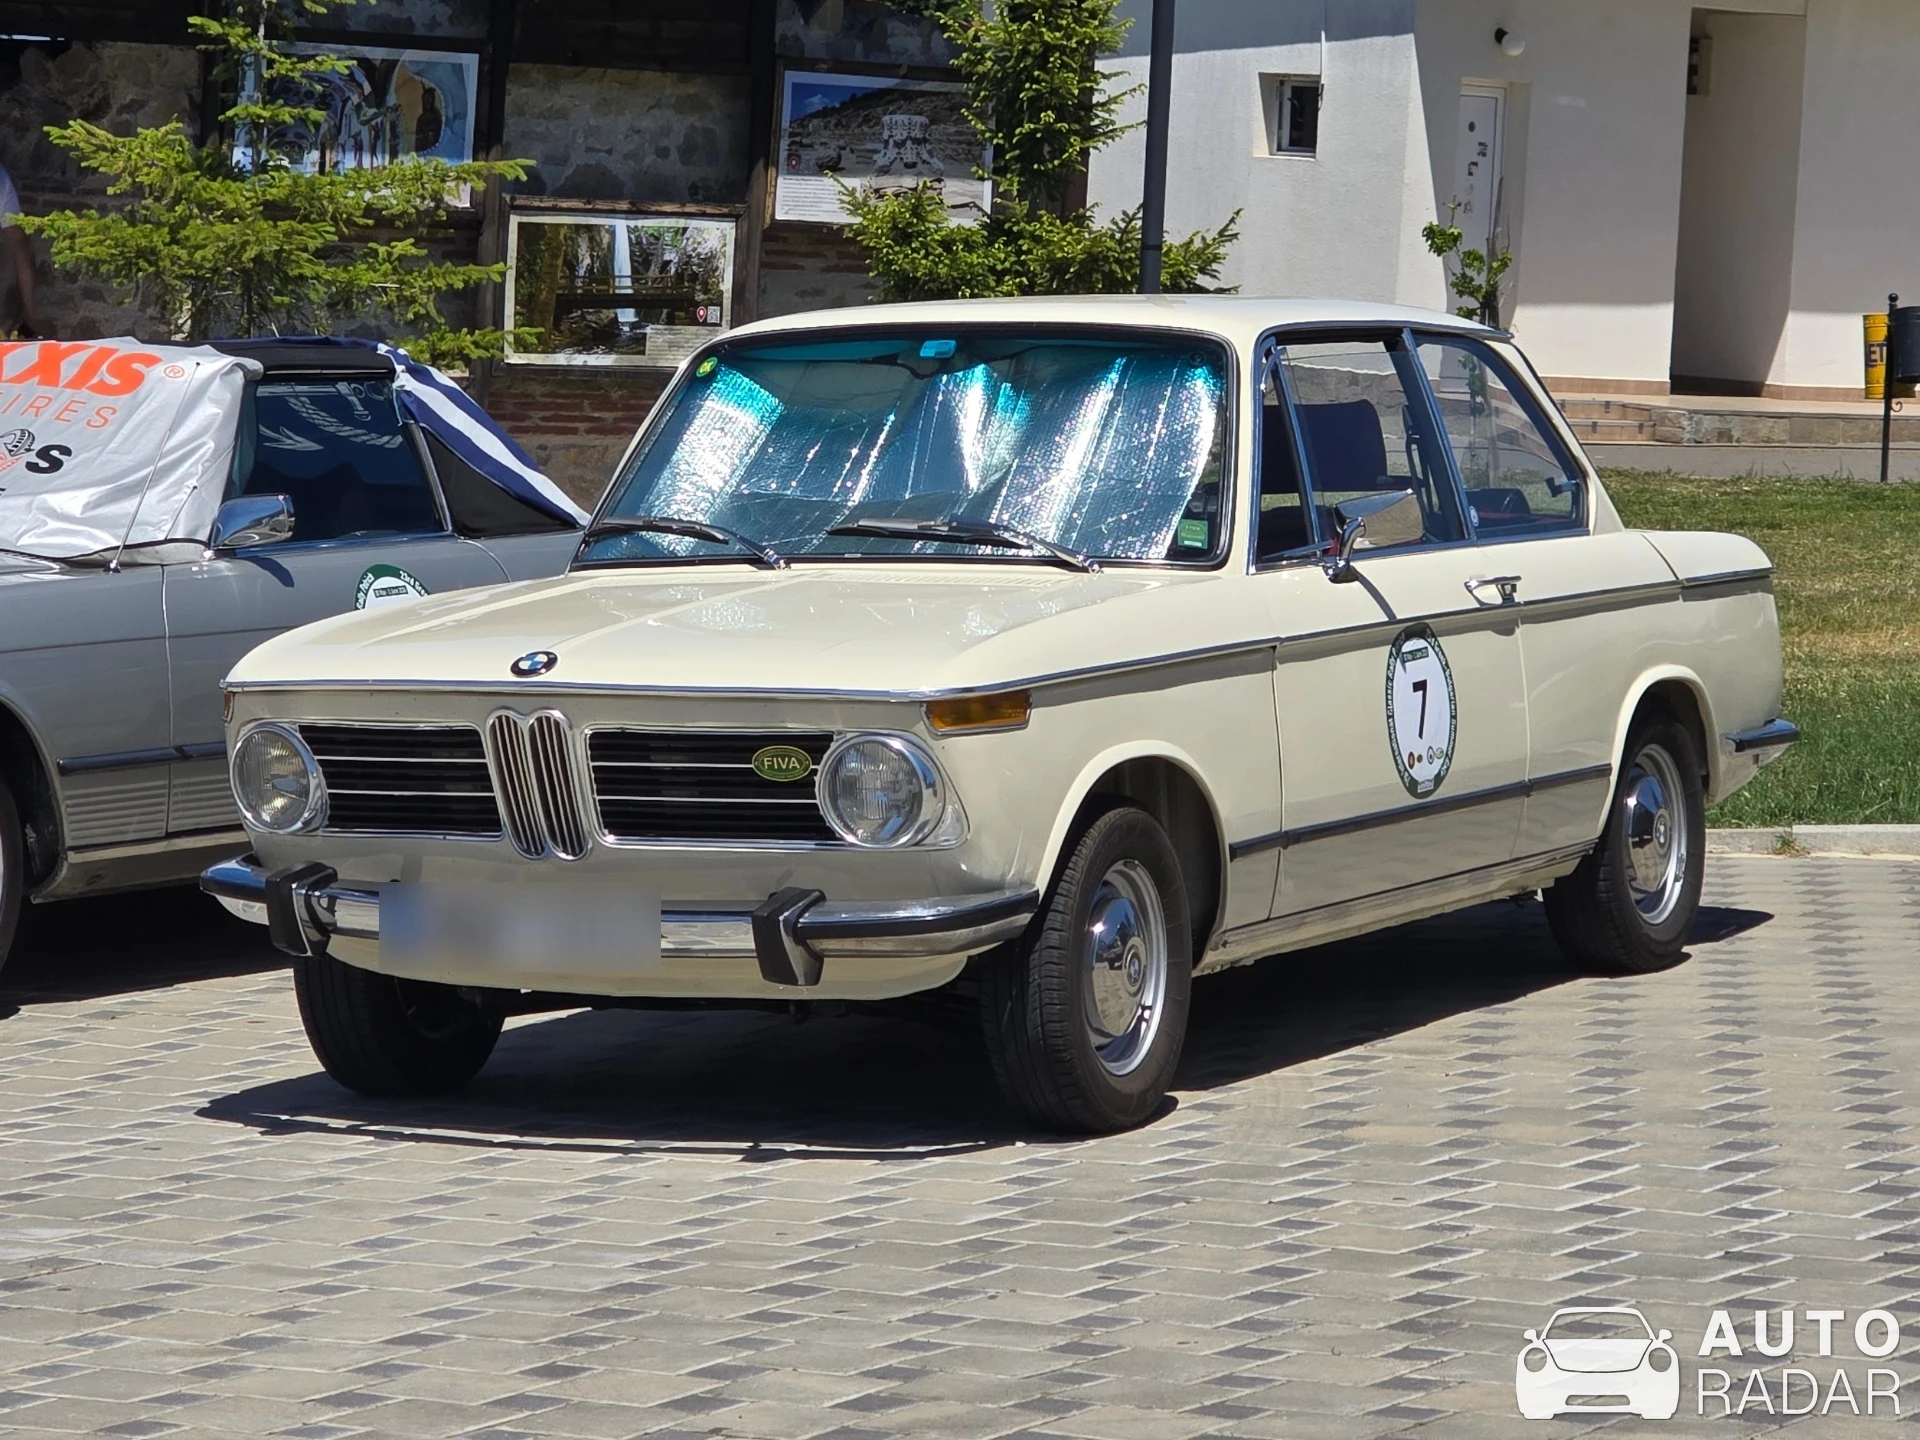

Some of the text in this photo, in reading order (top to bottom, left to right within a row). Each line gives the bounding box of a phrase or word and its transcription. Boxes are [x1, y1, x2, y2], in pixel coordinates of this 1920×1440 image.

[0, 391, 118, 429] IRES
[1412, 679, 1428, 740] 7
[763, 757, 800, 769] FIVA
